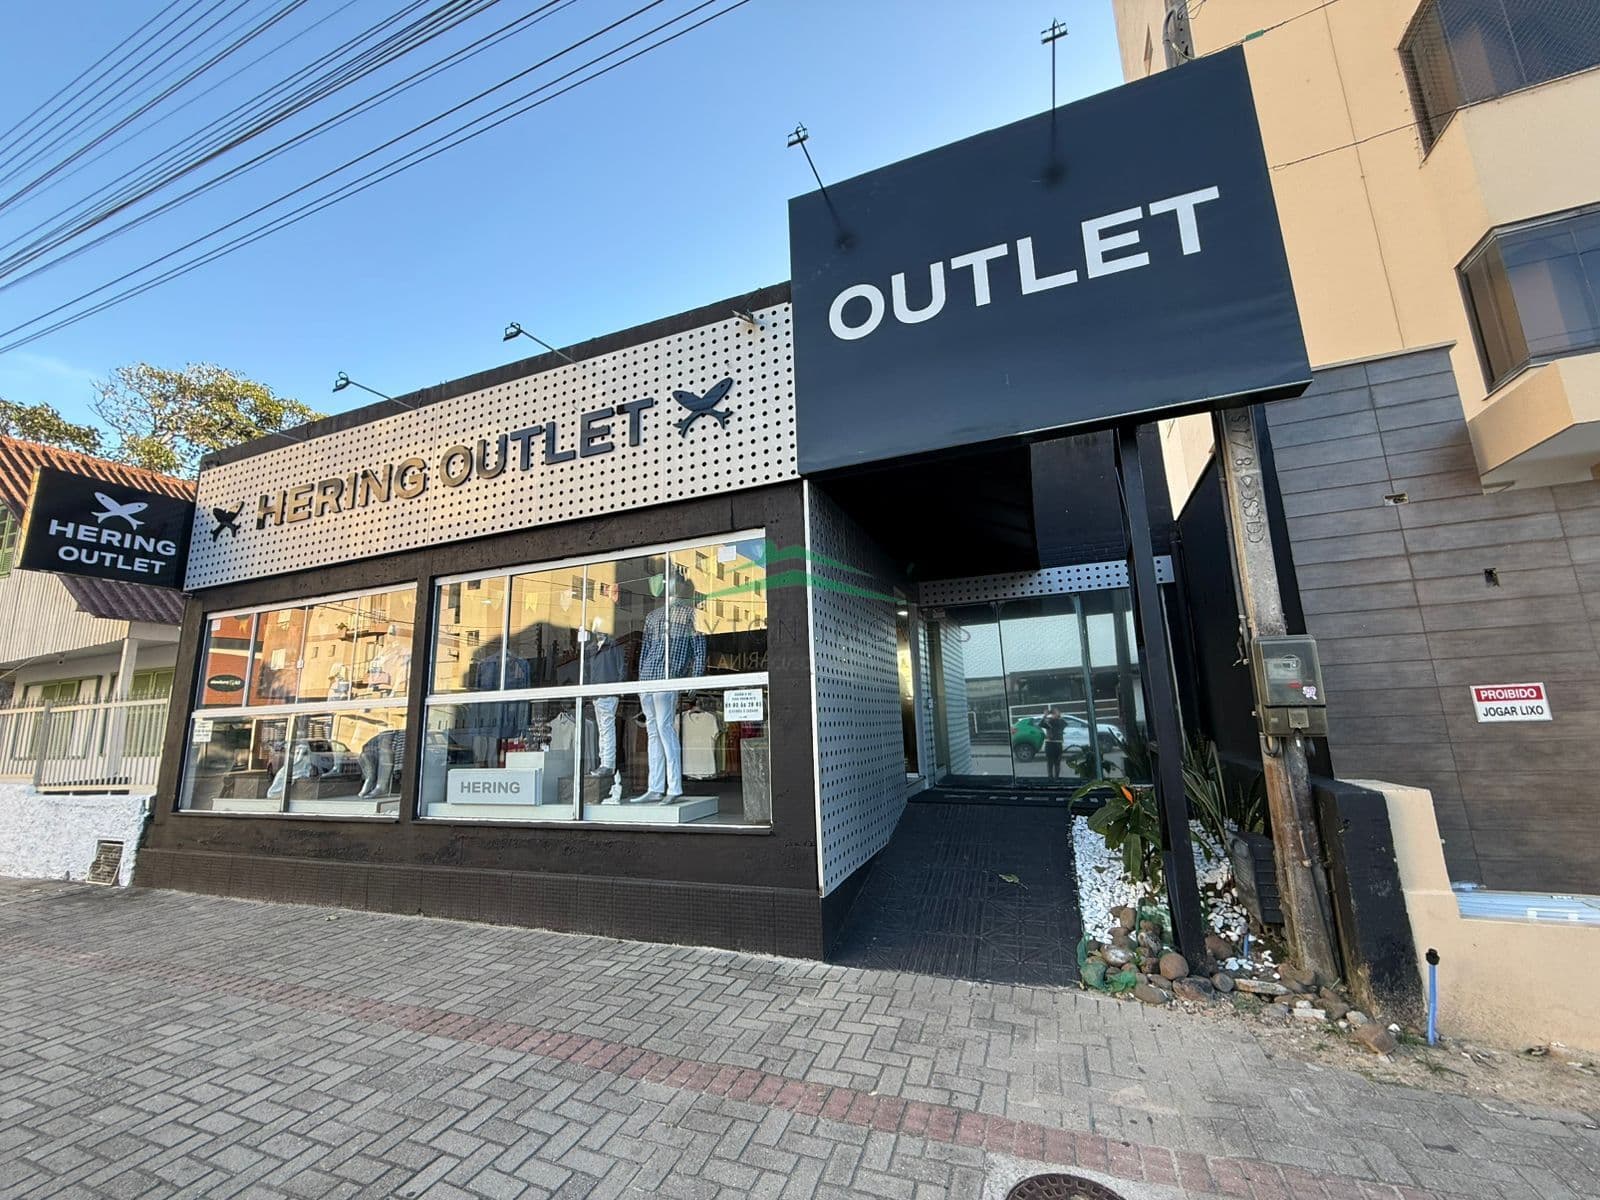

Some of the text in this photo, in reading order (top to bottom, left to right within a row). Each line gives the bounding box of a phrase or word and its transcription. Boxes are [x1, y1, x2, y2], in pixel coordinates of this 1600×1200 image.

[828, 185, 1220, 341] OUTLET
[256, 397, 654, 530] HERING OUTLET
[48, 519, 177, 556] HERING
[58, 545, 166, 575] OUTLET
[1480, 688, 1537, 700] PROIBIDO
[1483, 705, 1544, 717] JOGAR LIXO
[460, 781, 521, 794] HERING
